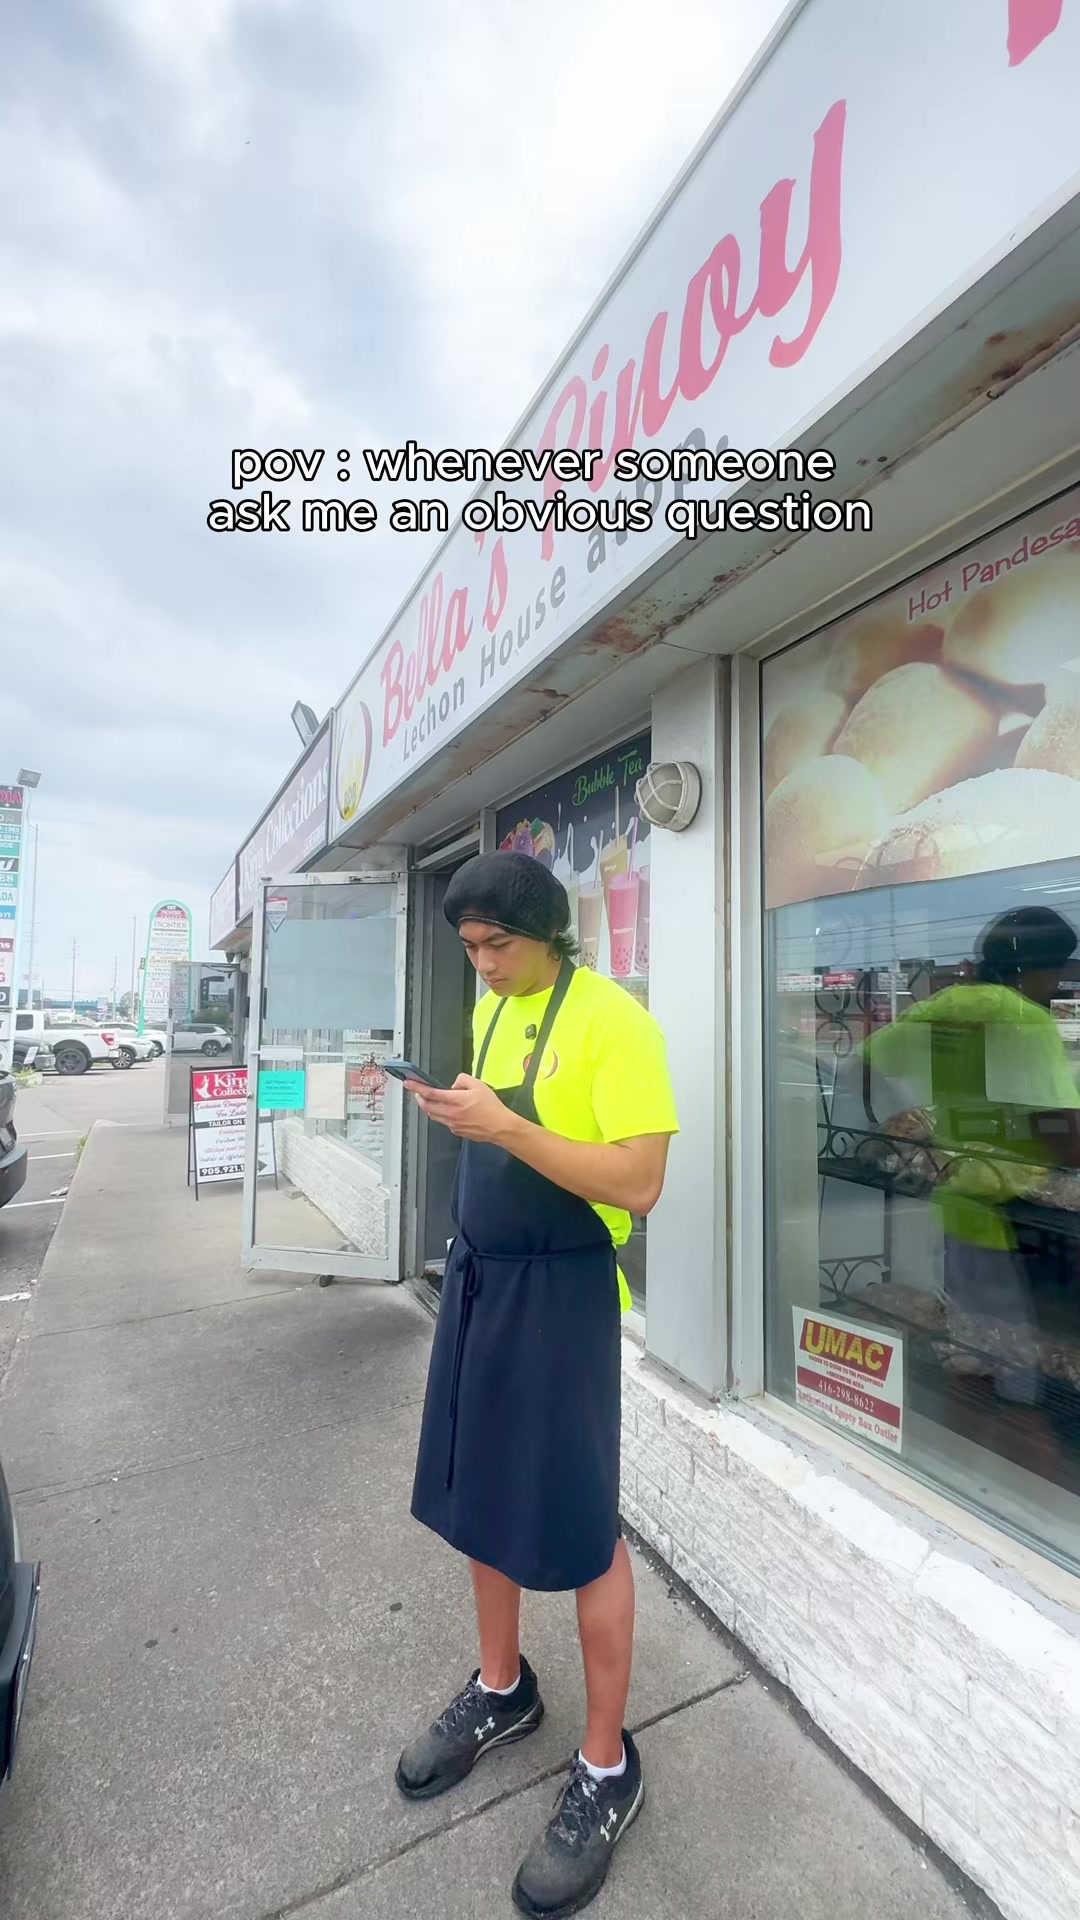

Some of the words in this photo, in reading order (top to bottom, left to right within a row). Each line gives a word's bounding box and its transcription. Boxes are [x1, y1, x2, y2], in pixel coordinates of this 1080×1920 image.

[380, 520, 508, 748] Bella's
[538, 99, 847, 562] Pinoy
[908, 580, 953, 622] Hot
[402, 676, 465, 763] Lechon
[479, 565, 567, 689] House
[572, 763, 616, 806] Bubble
[618, 749, 643, 787] Tea
[265, 757, 329, 863] Collections
[208, 1119, 232, 1127] TAILOR
[805, 1321, 885, 1371] UMAC
[818, 1379, 875, 1413] 416-298-8622
[858, 1416, 873, 1432] Box
[873, 1423, 899, 1444] Outlet
